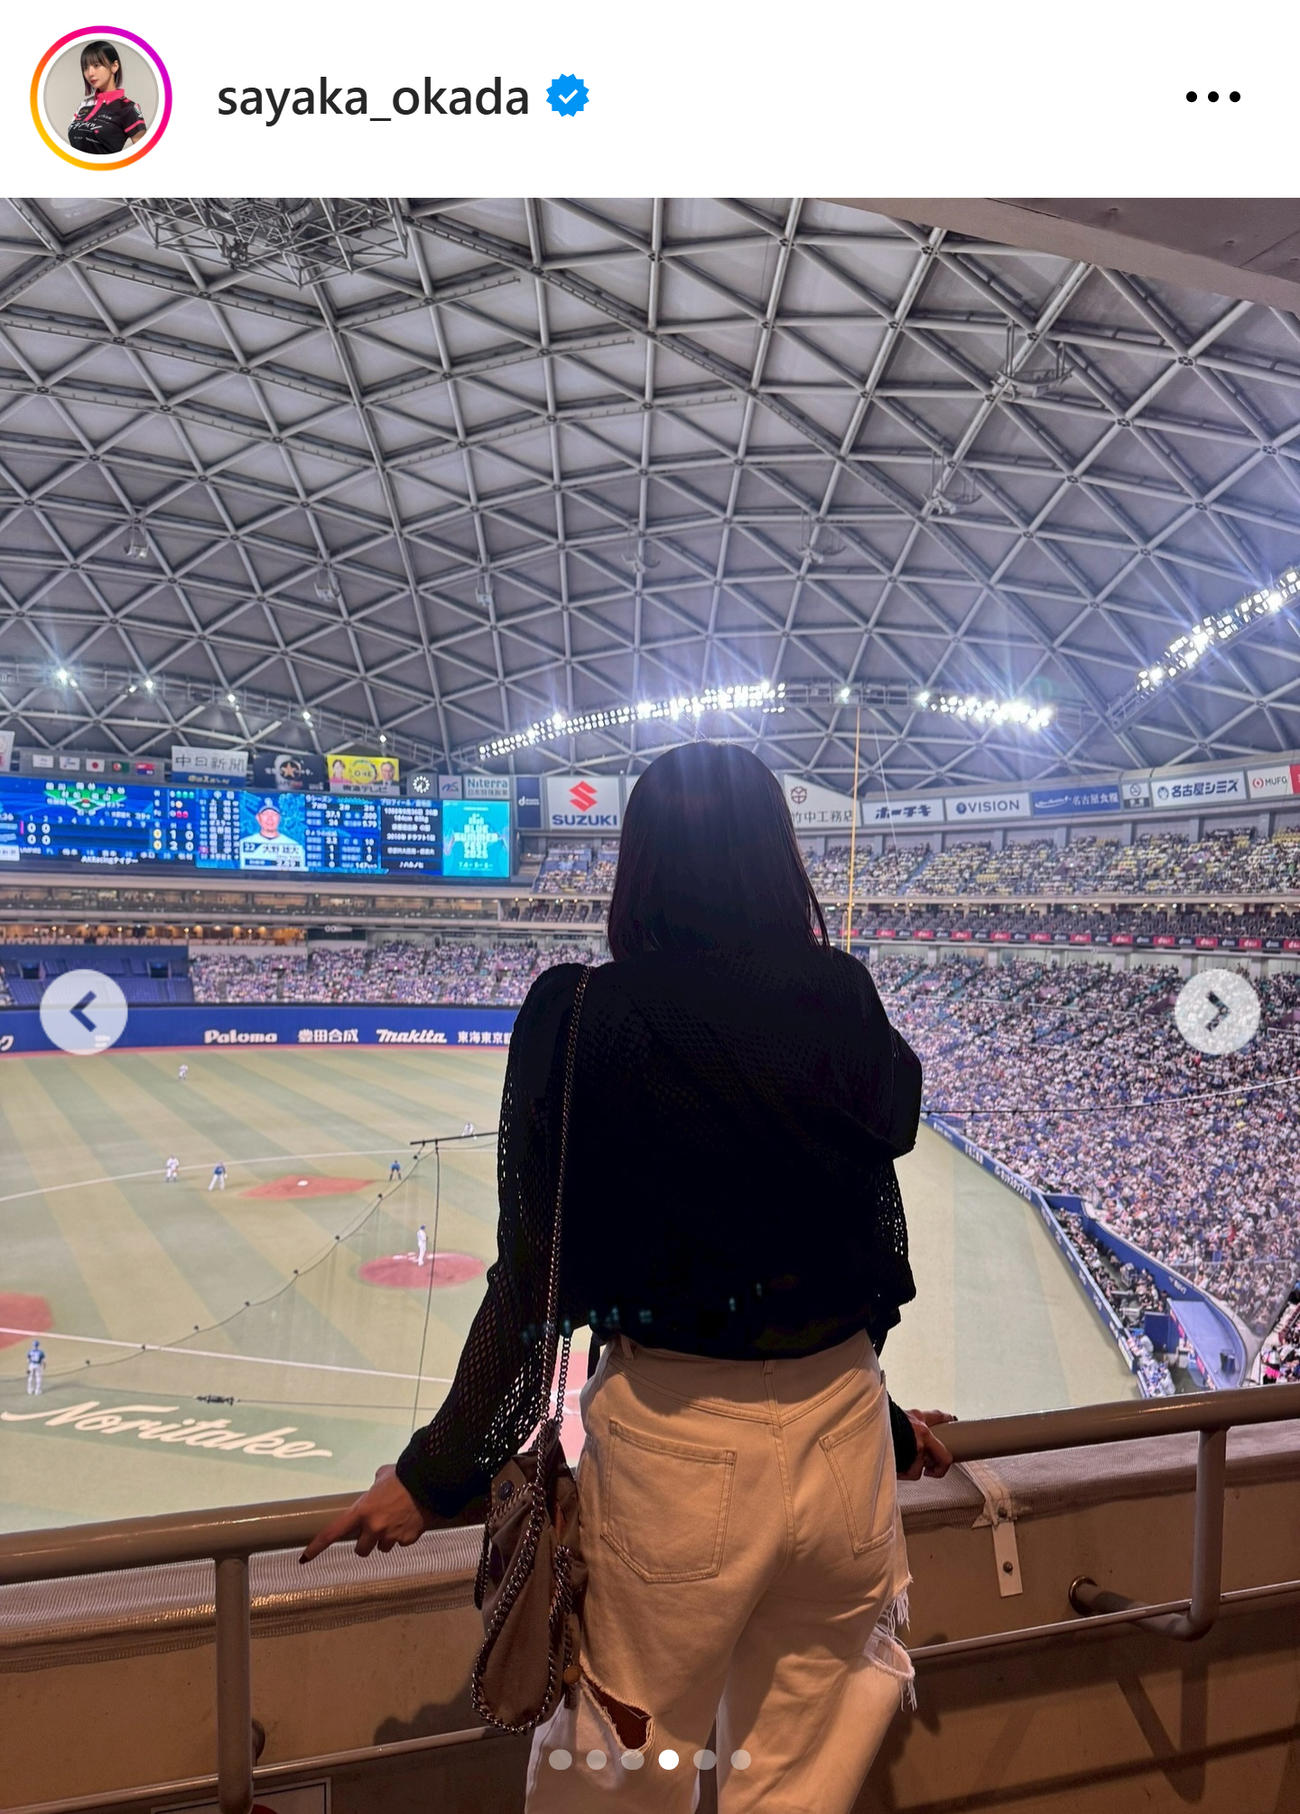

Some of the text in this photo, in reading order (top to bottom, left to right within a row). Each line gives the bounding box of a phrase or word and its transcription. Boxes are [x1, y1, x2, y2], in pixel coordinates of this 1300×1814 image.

[175, 754, 245, 772] 中日新聞
[467, 778, 508, 789] Niterra
[1265, 775, 1288, 786] MUFG
[1171, 779, 1238, 798] 名古屋シミズ
[875, 804, 931, 820] ホーチキ
[968, 800, 1020, 813] VISION
[552, 814, 617, 826] SUZUKI
[791, 810, 854, 823] 竹中工務店
[170, 829, 177, 840] 1
[169, 840, 178, 851] 2
[204, 1029, 278, 1043] Paloma
[298, 1028, 359, 1043] 豊田合成
[376, 1028, 447, 1043] Makita
[0, 1400, 333, 1458] Noritake
